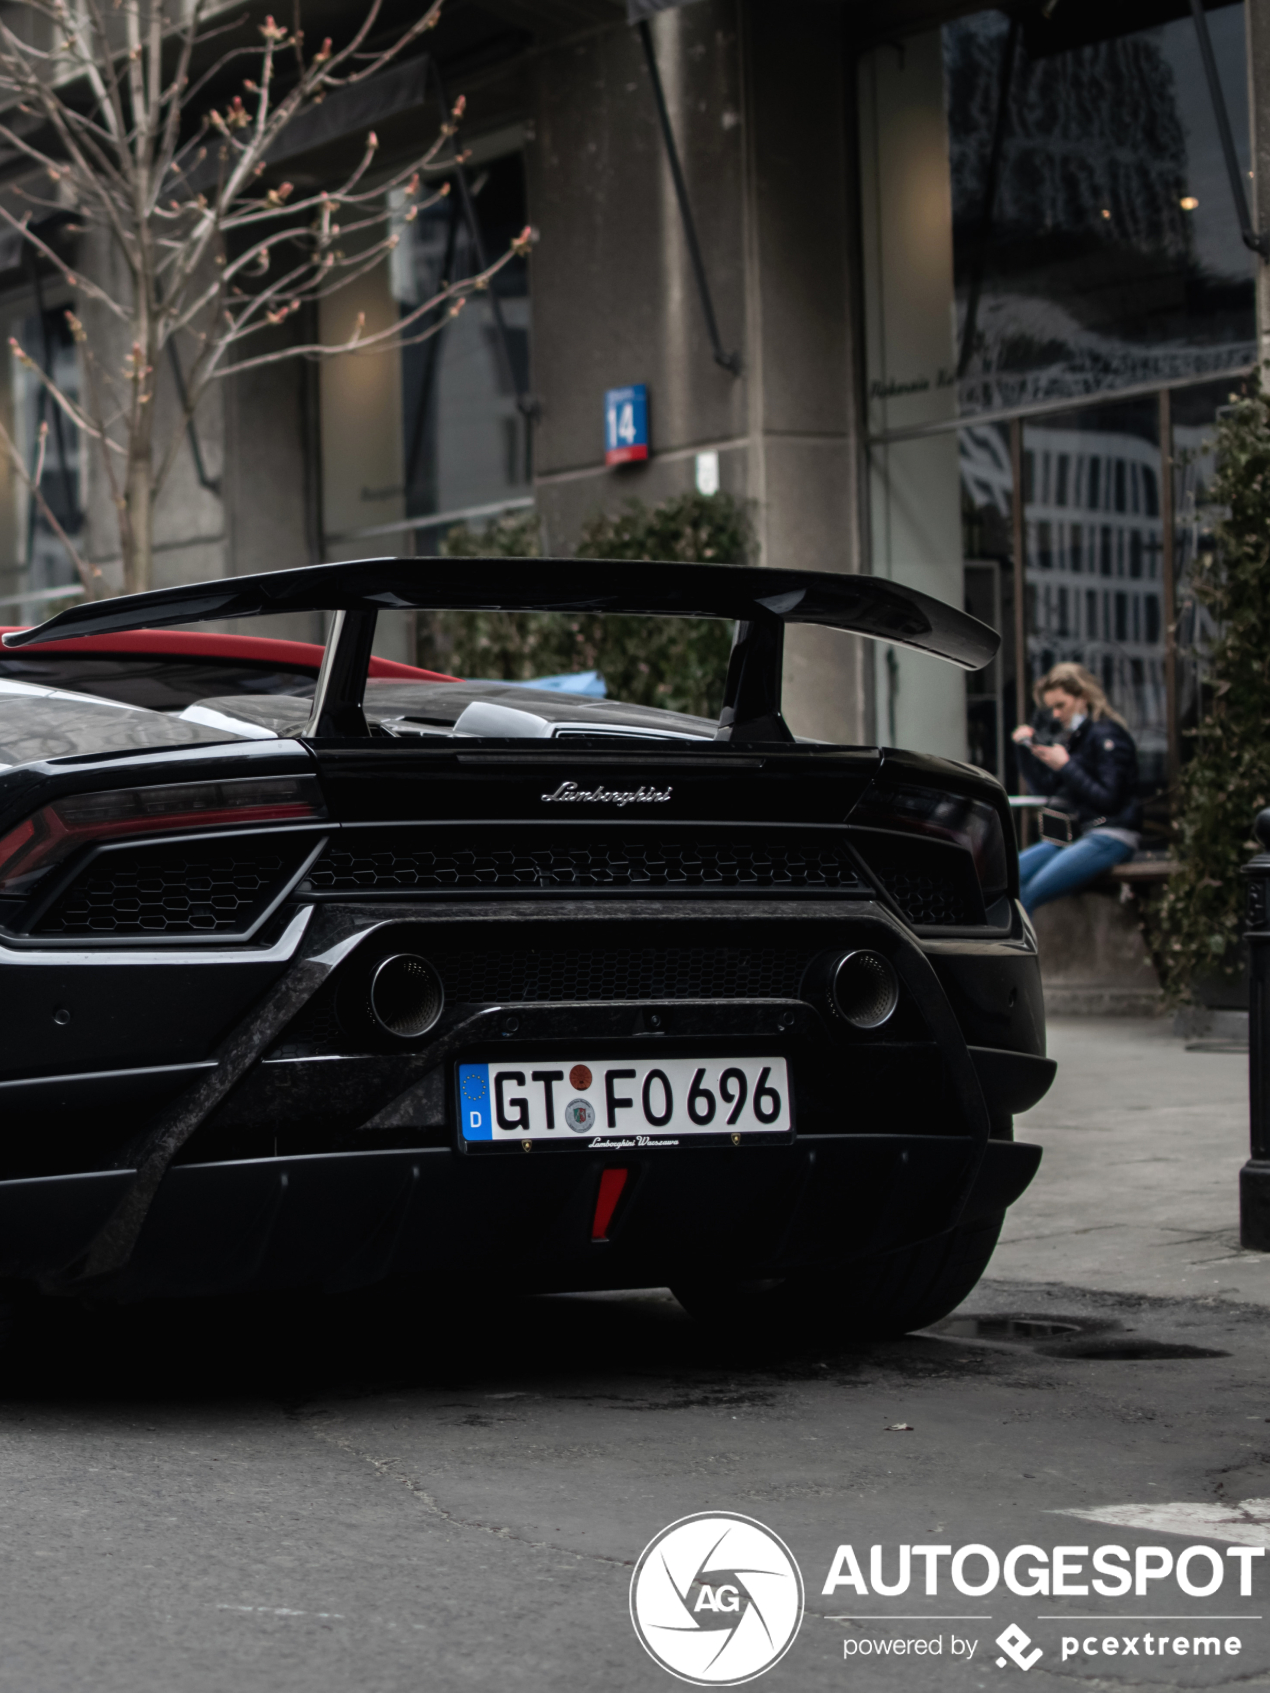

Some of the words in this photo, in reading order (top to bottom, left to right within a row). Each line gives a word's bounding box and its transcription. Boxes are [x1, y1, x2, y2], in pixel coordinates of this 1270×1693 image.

[607, 402, 636, 449] 14
[541, 781, 673, 807] Lamborghini
[494, 1071, 564, 1131] GT
[604, 1068, 674, 1129] FO
[687, 1066, 782, 1126] 696
[470, 1111, 482, 1128] D
[588, 1136, 635, 1149] Lamborghini
[635, 1135, 679, 1147] Warszawa
